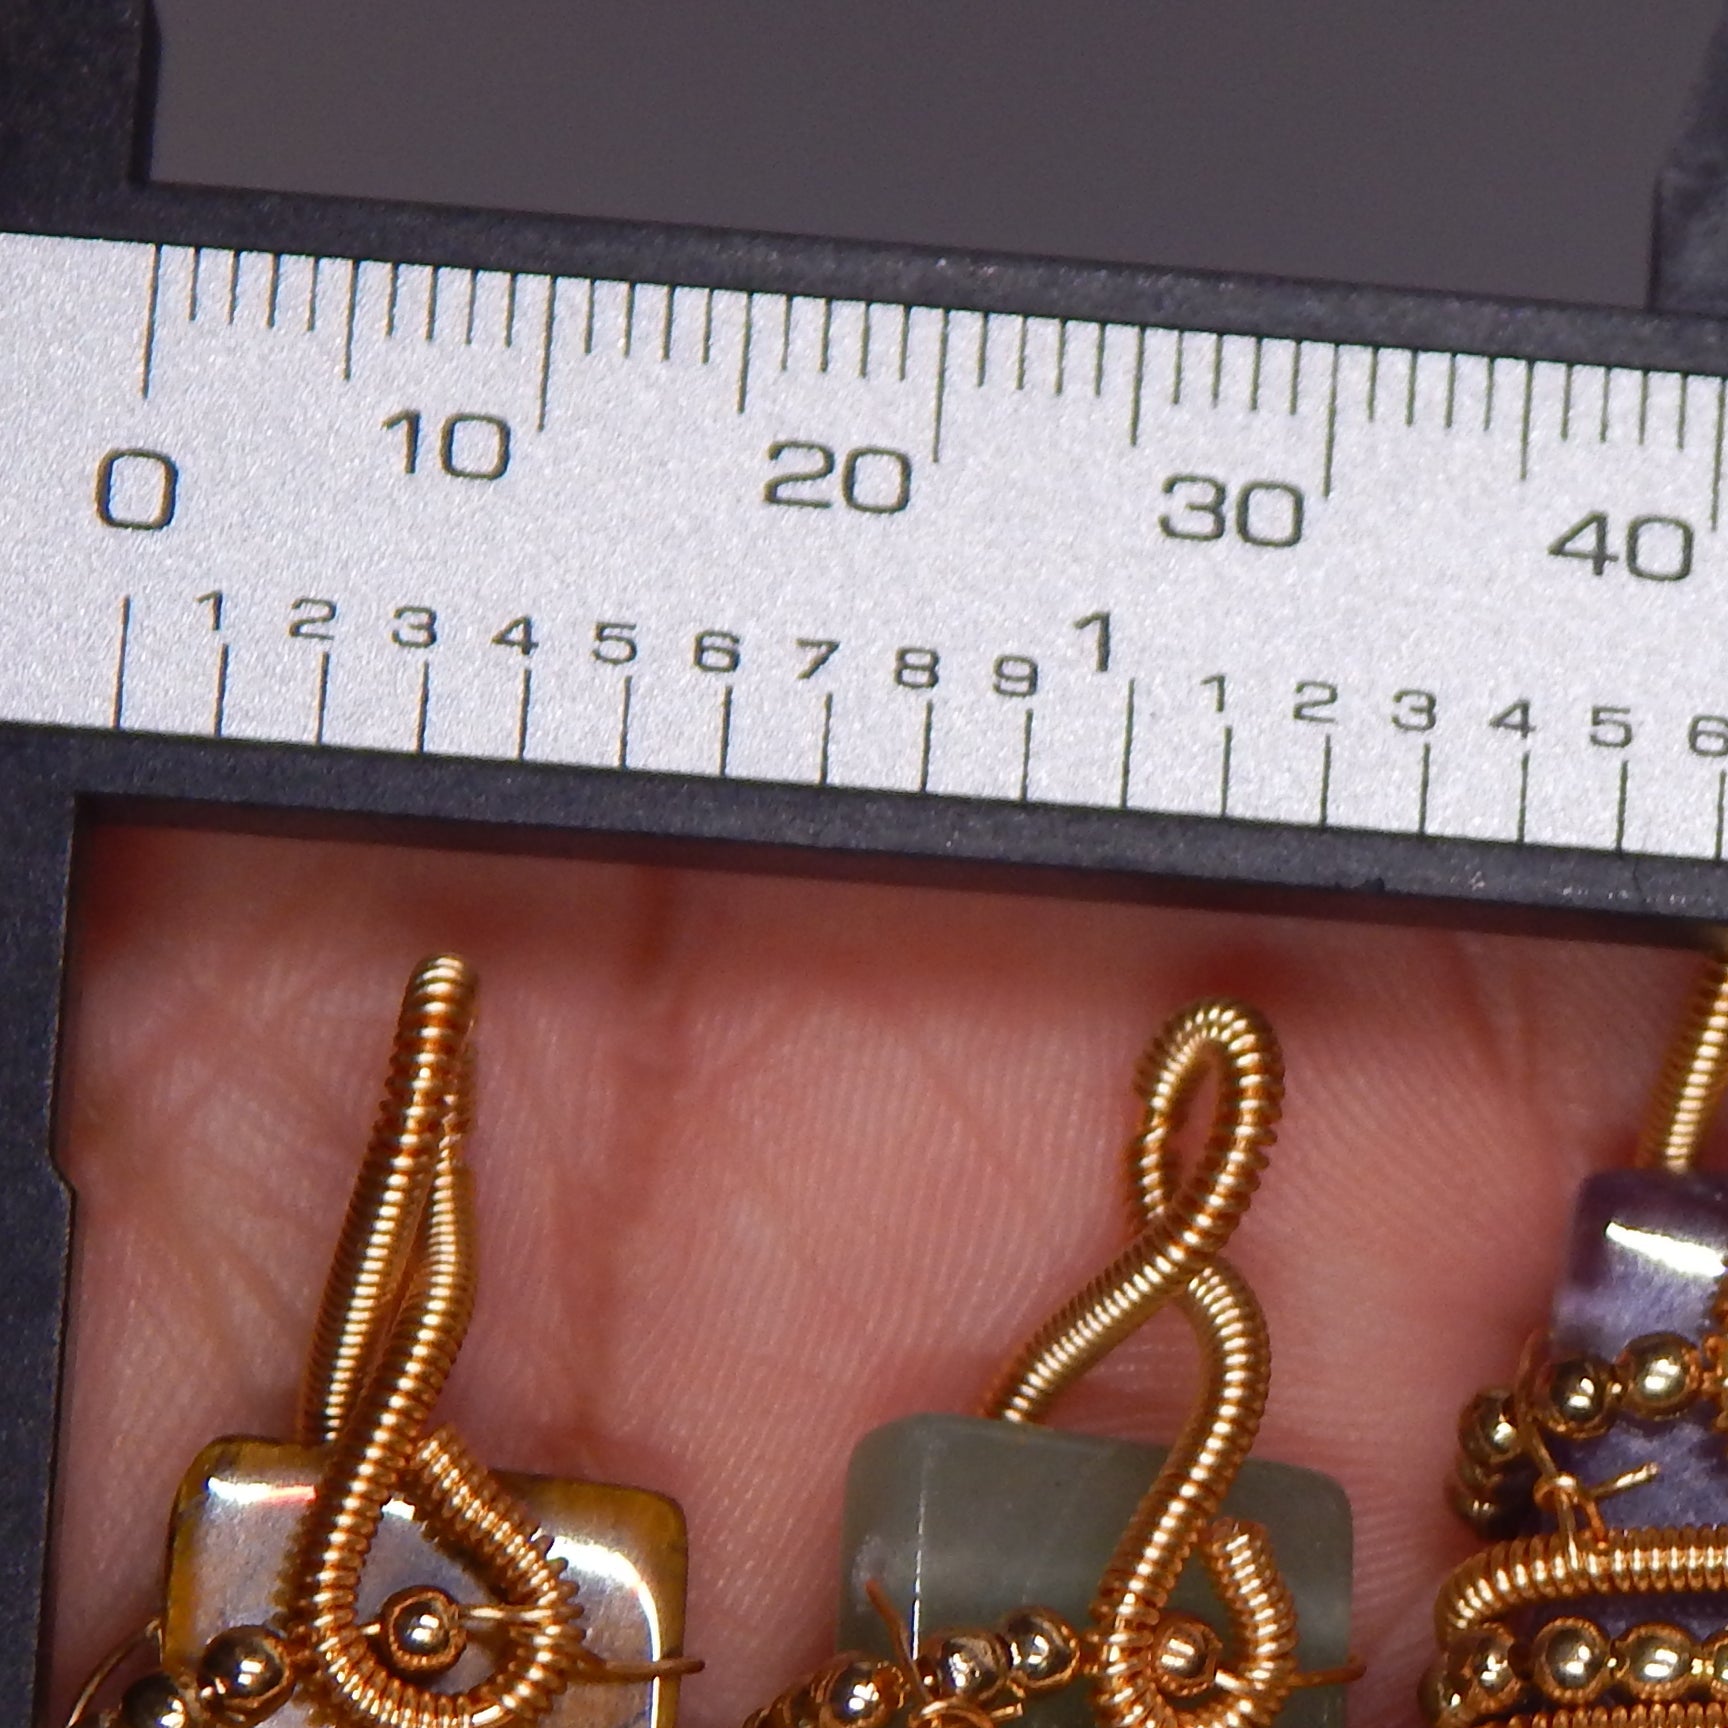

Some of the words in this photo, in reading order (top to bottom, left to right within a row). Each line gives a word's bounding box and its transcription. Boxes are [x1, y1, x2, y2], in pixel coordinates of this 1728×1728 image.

[95, 448, 179, 531] 0
[383, 410, 511, 482] 10
[764, 440, 912, 516] 20
[1159, 474, 1305, 549] 30
[1548, 512, 1694, 583] 40
[198, 591, 223, 631] 1
[289, 597, 337, 641] 2
[392, 606, 437, 649] 3
[492, 616, 539, 656] 4
[592, 622, 638, 666] 5
[694, 630, 740, 673] 6
[797, 639, 840, 680] 7
[894, 647, 940, 690] 8
[993, 655, 1039, 699] 9
[1074, 612, 1111, 673] 1
[1202, 674, 1226, 713] 1
[1293, 681, 1338, 723] 2
[1392, 689, 1437, 733] 3
[1489, 699, 1536, 740] 4
[1590, 706, 1634, 749] 5
